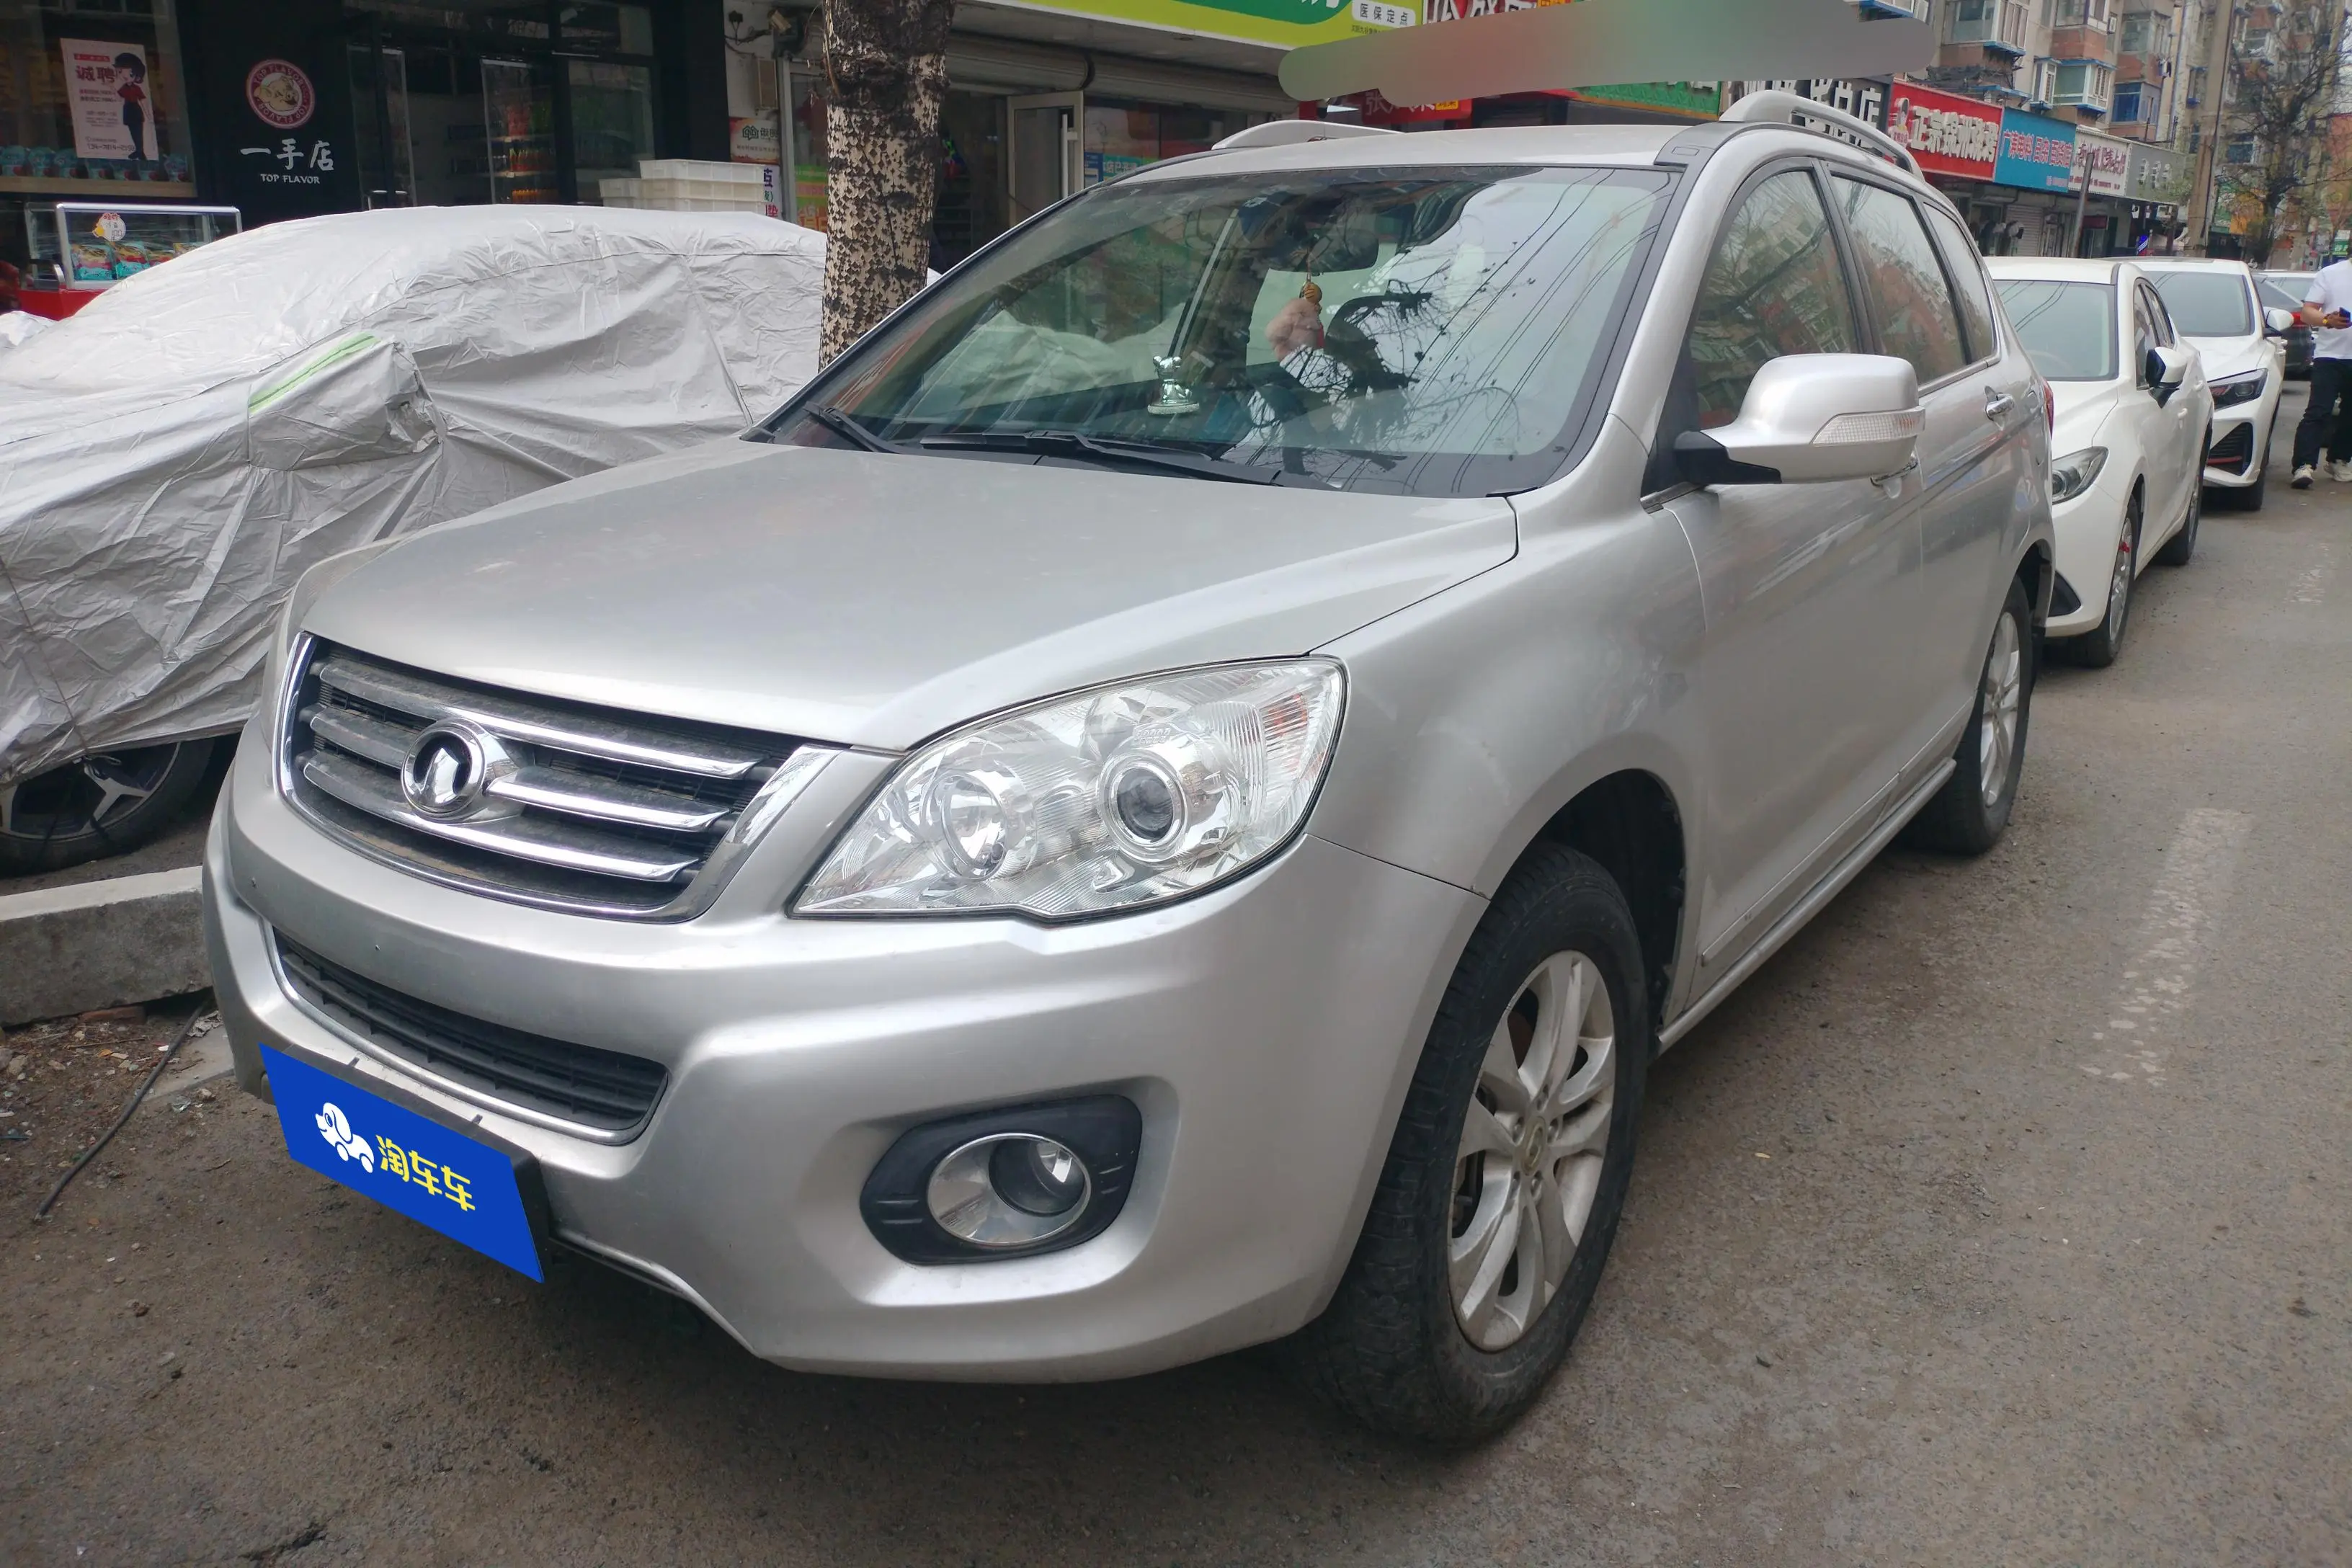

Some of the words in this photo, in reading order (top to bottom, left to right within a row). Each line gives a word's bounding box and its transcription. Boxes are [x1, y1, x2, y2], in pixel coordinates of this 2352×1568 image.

[1360, 3, 1409, 26] 医保定点
[75, 65, 115, 83] 诚聘
[240, 138, 334, 171] 一手店
[260, 174, 280, 182] TOP
[282, 174, 321, 184] FLAVOR
